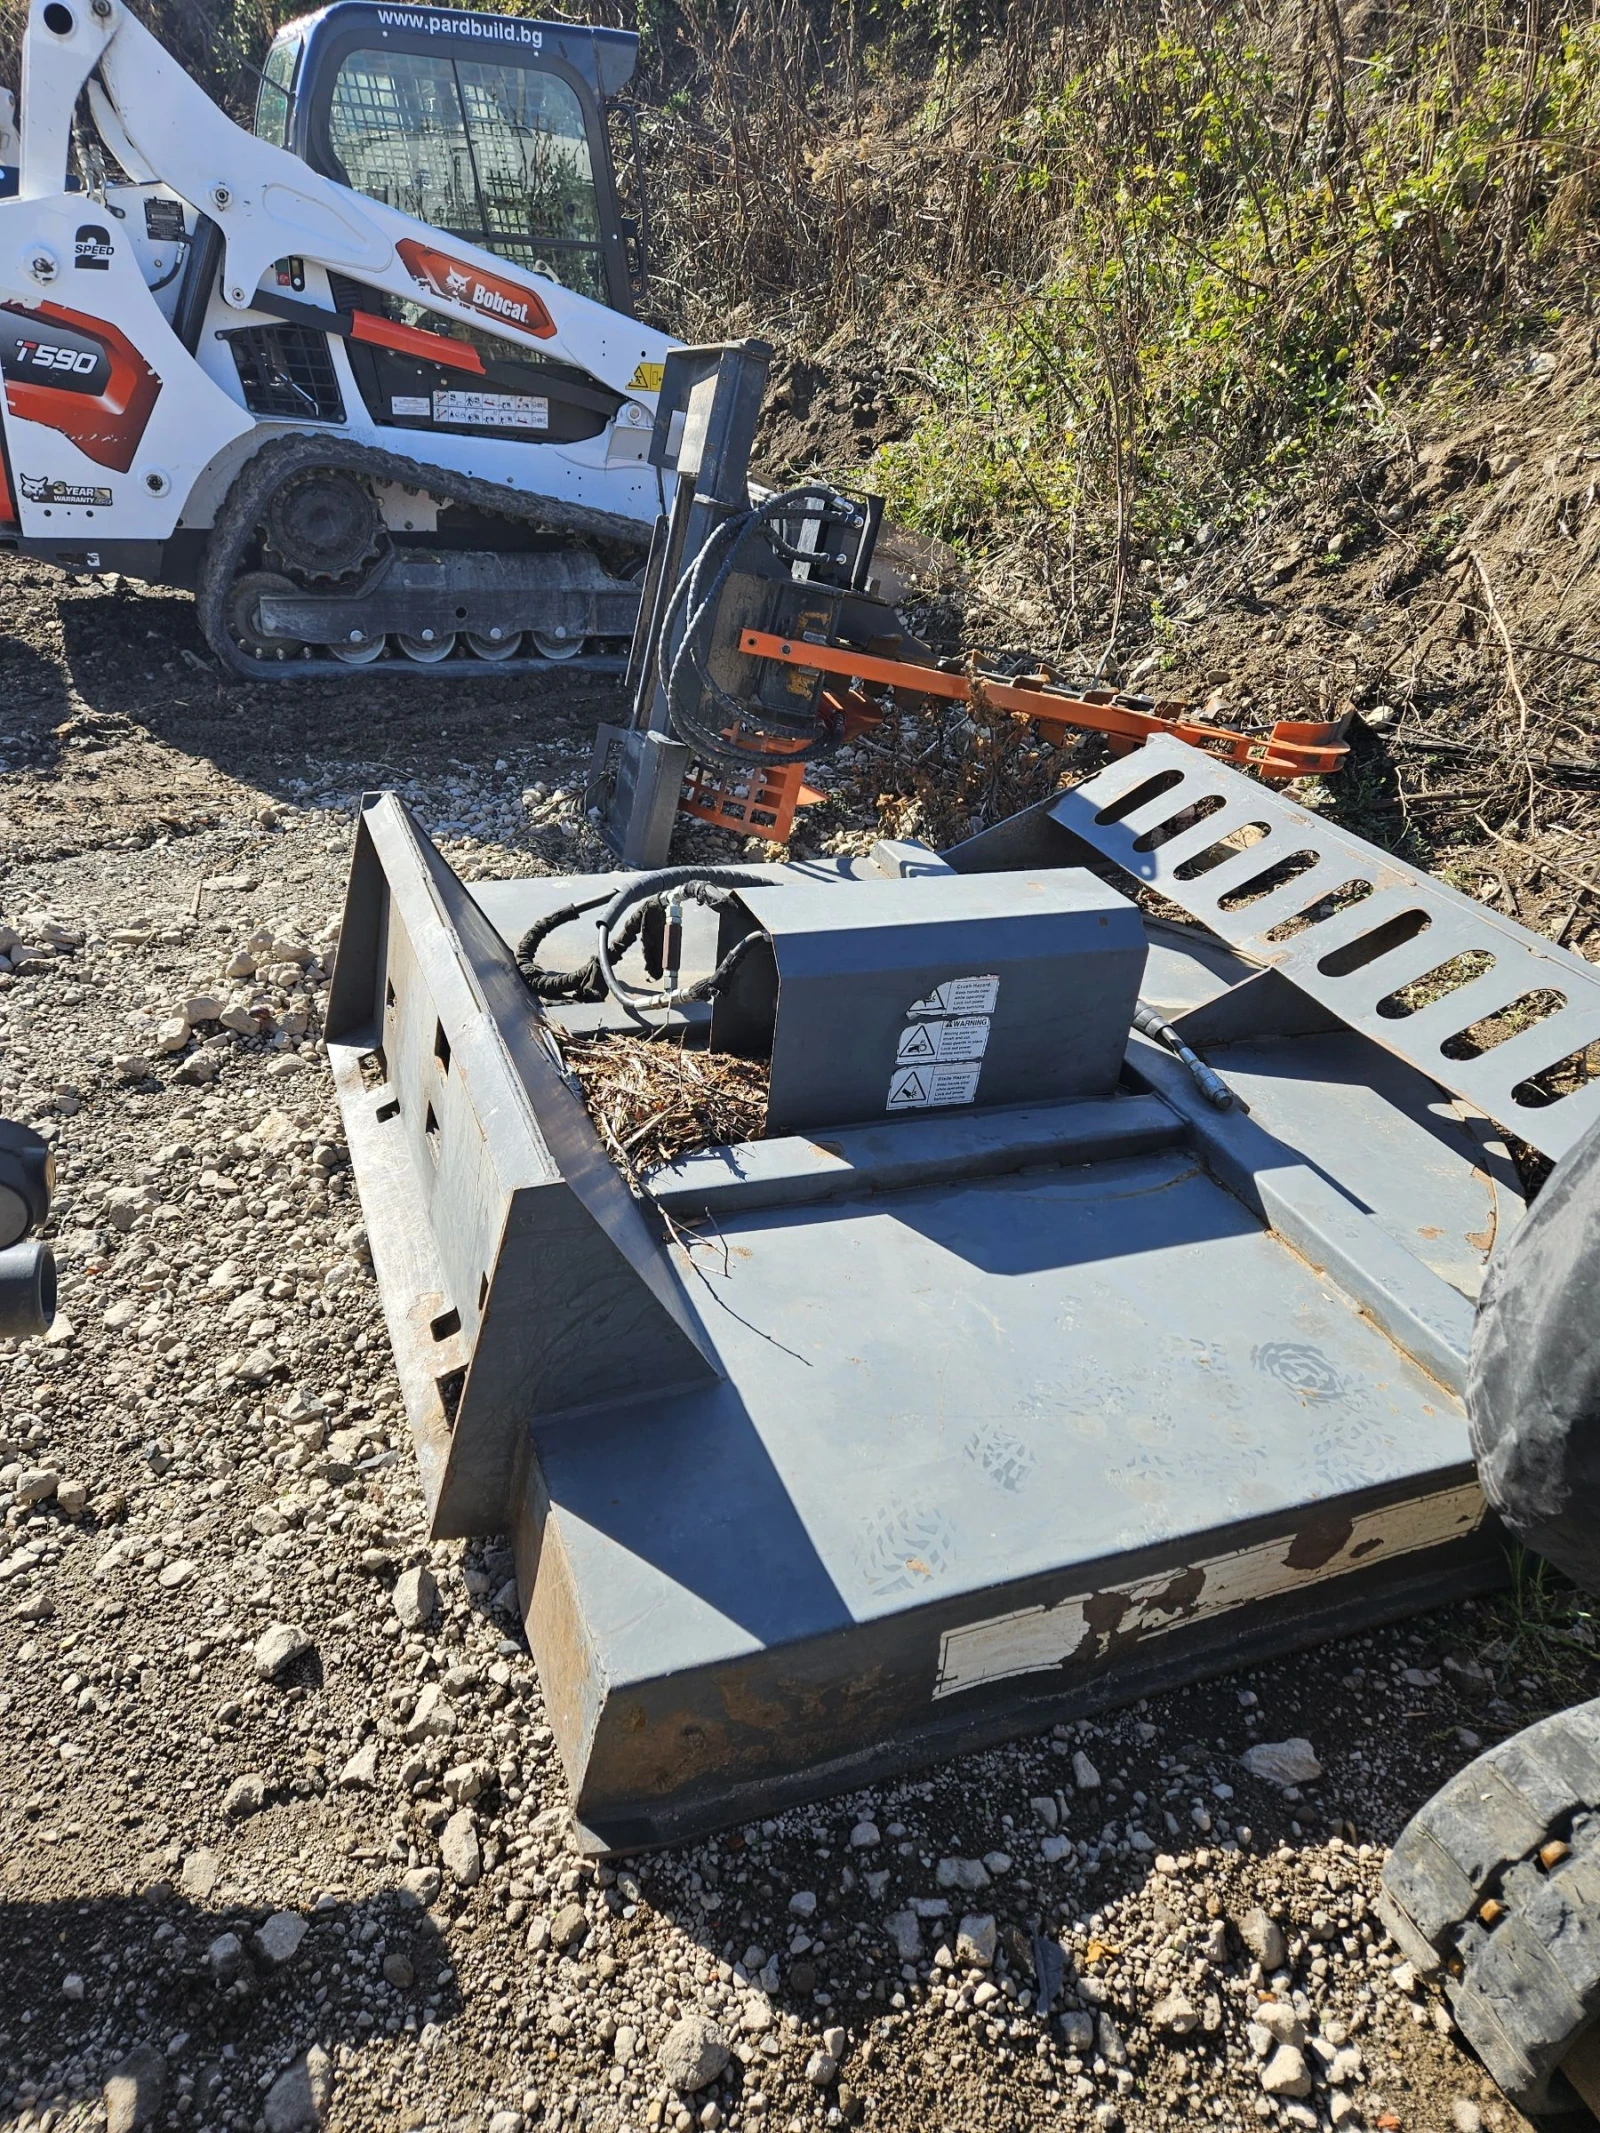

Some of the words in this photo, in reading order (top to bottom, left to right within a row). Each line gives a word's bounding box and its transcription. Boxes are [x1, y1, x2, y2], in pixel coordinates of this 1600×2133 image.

[377, 9, 543, 49] www.pardbuild.bg
[74, 244, 115, 256] SPEED
[472, 283, 528, 323] Bobcat
[16, 340, 98, 374] T590
[53, 480, 67, 495] 3
[65, 486, 94, 497] YEAR
[53, 495, 95, 504] WARRANTY
